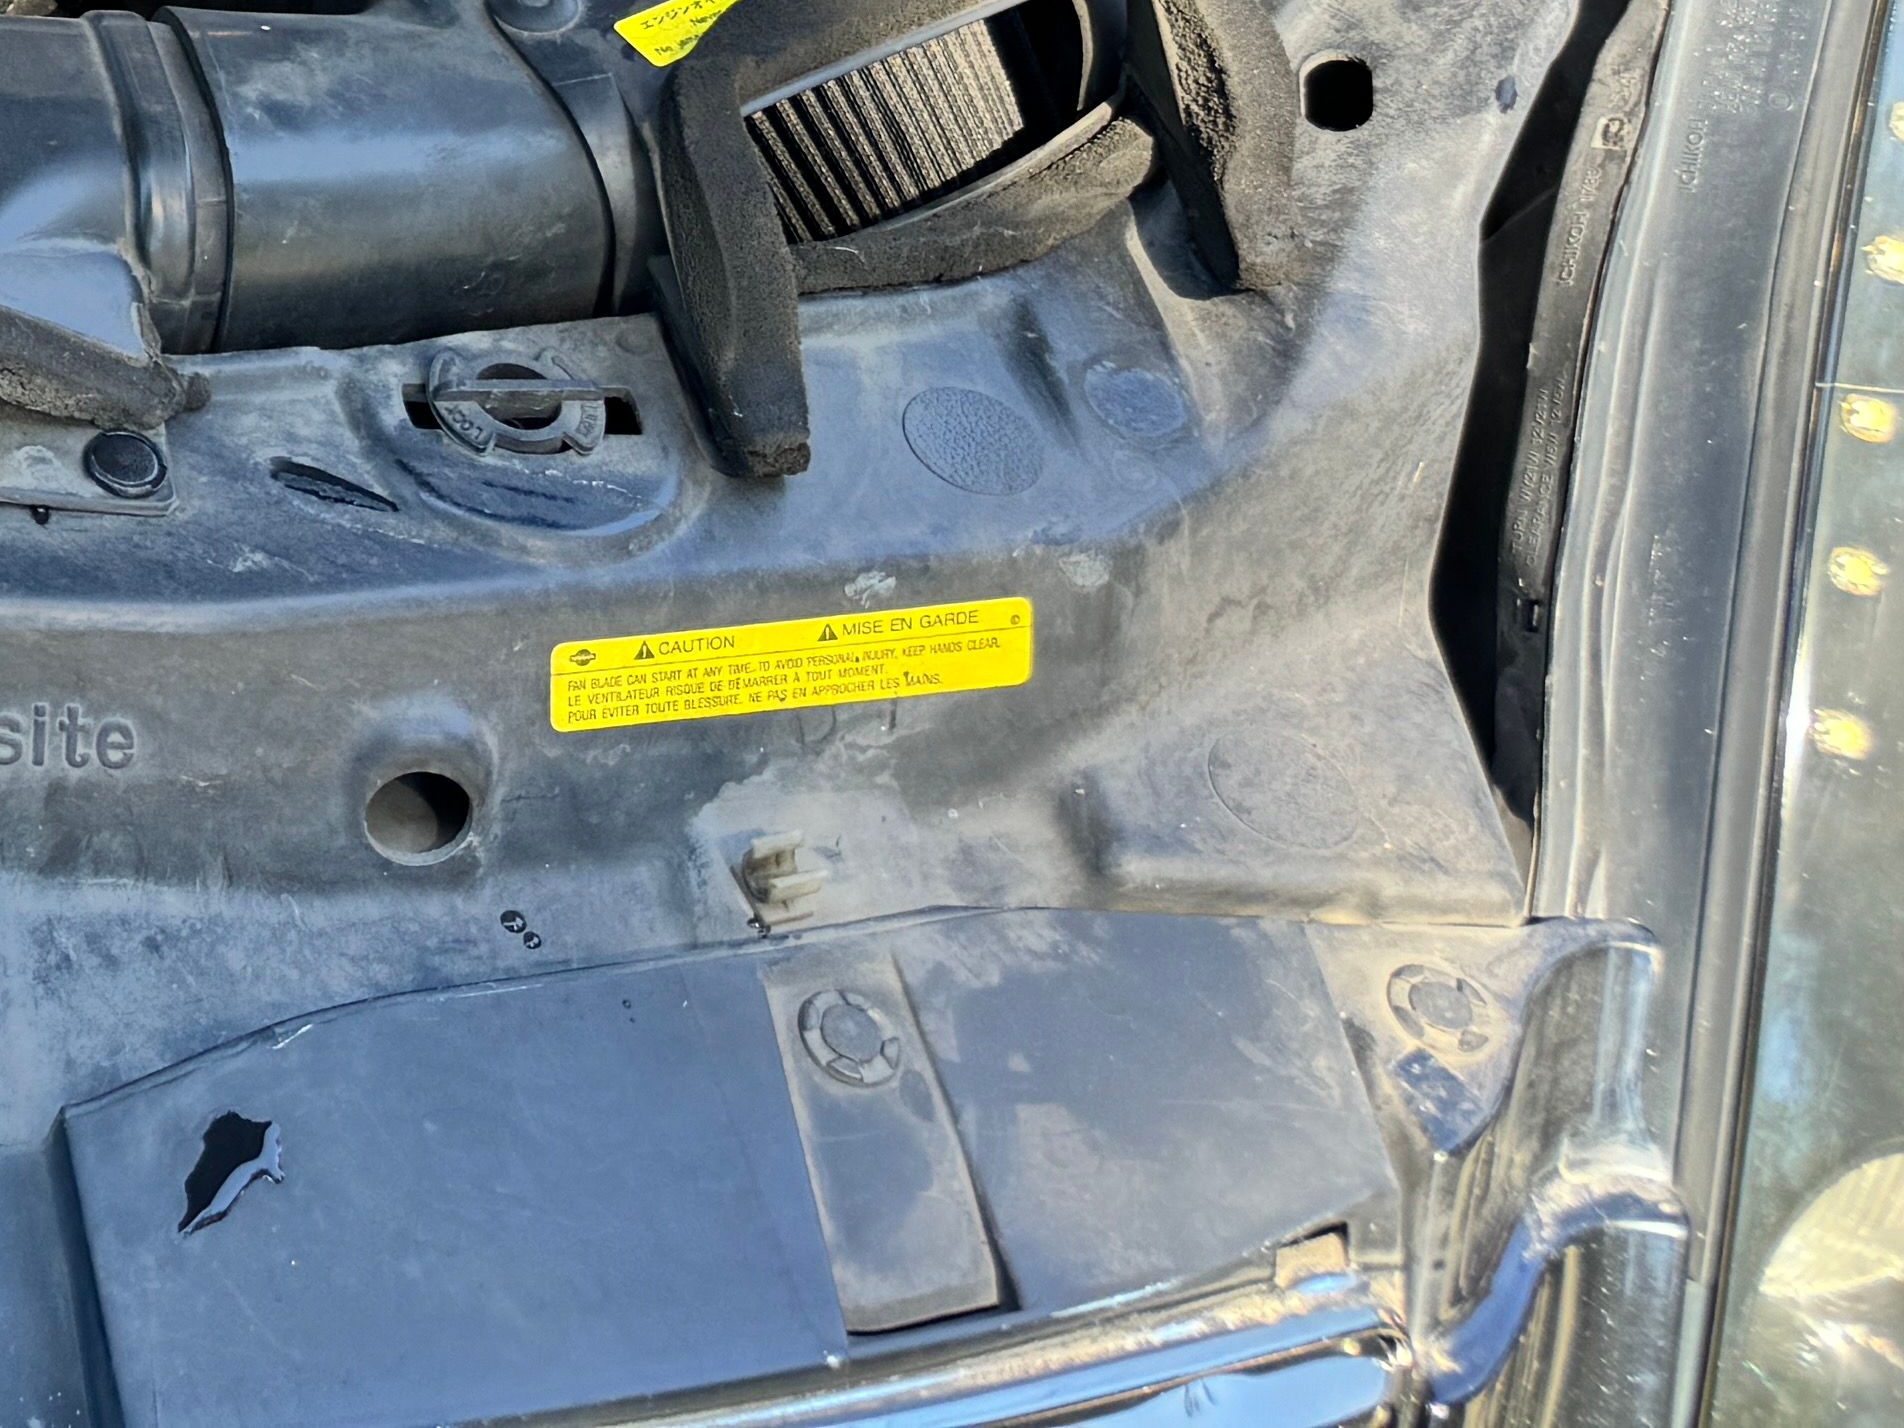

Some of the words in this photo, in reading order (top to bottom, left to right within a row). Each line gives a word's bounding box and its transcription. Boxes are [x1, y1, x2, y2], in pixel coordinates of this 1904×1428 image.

[1678, 117, 1705, 193] ICHIKOH
[1556, 207, 1590, 287] ICHIKOH
[657, 634, 736, 656] CAUTION
[841, 618, 883, 637] MISE
[889, 615, 912, 632] EN
[918, 607, 979, 629] GARDE
[567, 679, 586, 692] FAN
[590, 675, 623, 689] BLADE
[626, 672, 646, 686] CAN
[651, 669, 682, 683] START
[686, 667, 698, 679] AT
[702, 664, 722, 678] ANY
[759, 660, 769, 672] TO
[774, 656, 802, 670] AVOID
[929, 640, 962, 655] HANDS
[567, 694, 581, 707] LE
[587, 686, 659, 705] VENTILATEUR
[665, 681, 704, 697] RISQUE
[710, 679, 724, 692] DE
[806, 668, 832, 682] TOUT
[567, 708, 596, 723] POUR
[645, 699, 679, 714] TOUTE
[748, 690, 762, 703] NE
[767, 687, 787, 701] PAS
[792, 685, 806, 699] EN
[811, 678, 875, 697] APPROCHER
[880, 676, 899, 689] LES
